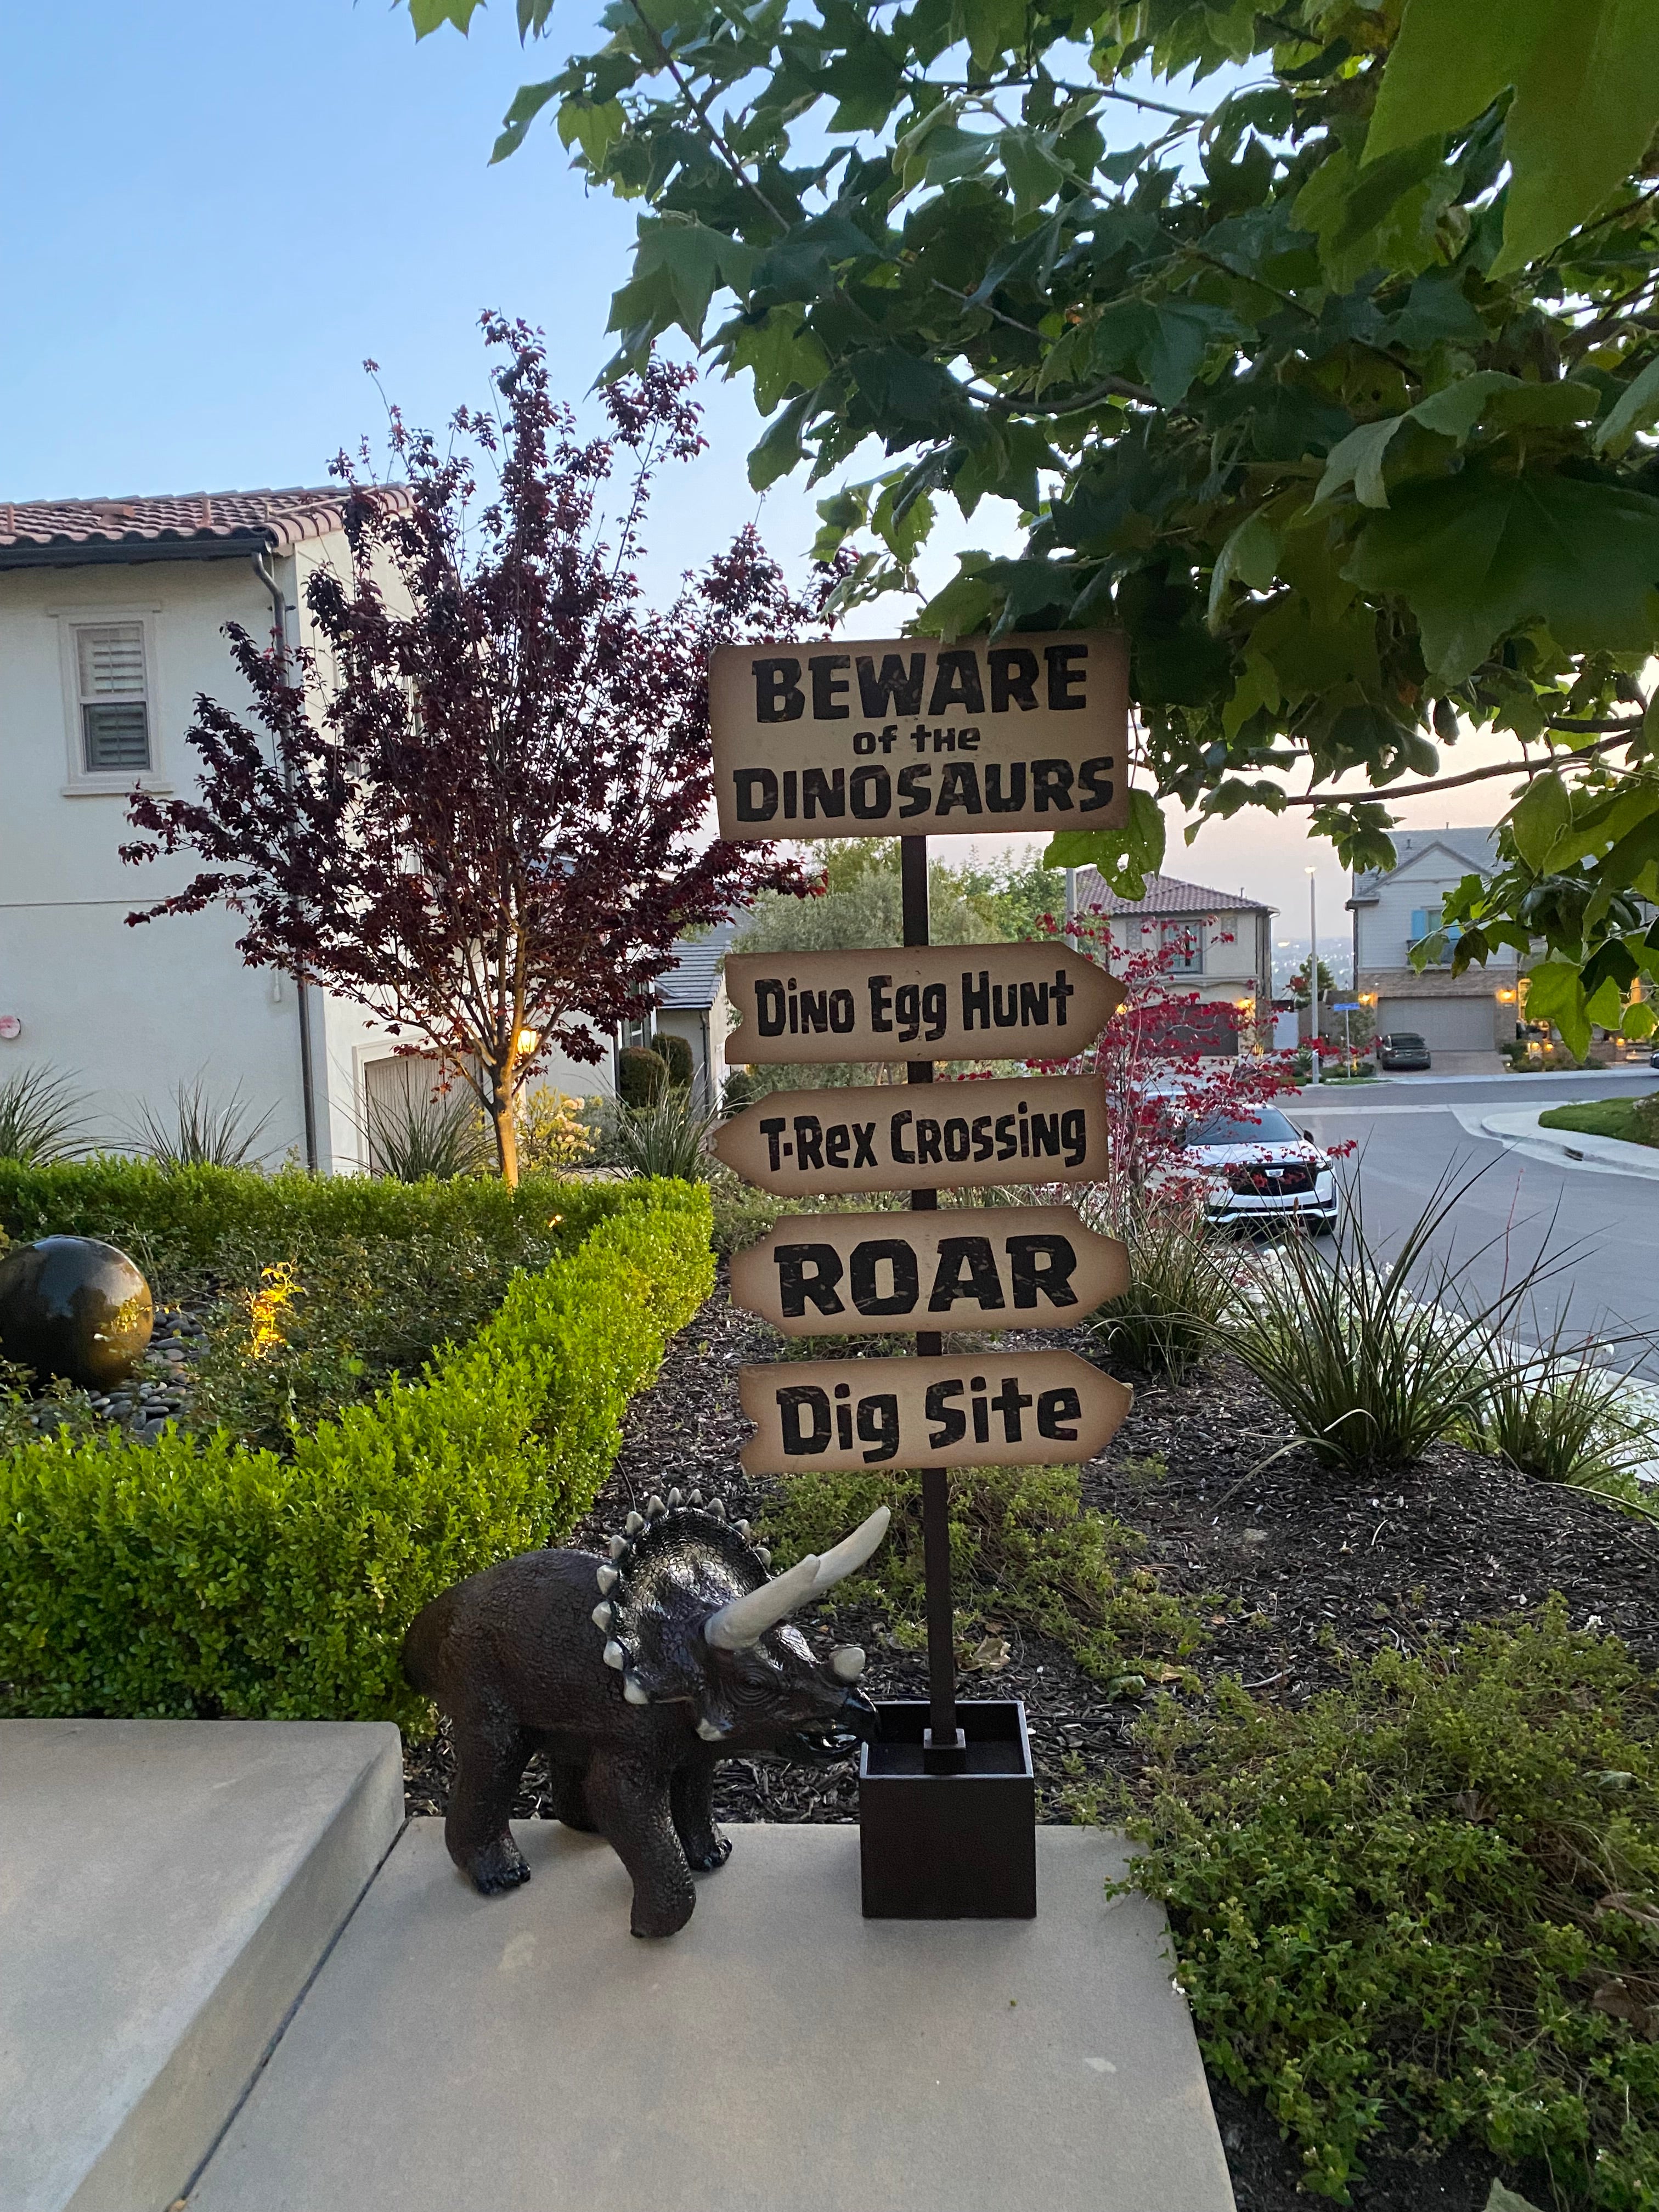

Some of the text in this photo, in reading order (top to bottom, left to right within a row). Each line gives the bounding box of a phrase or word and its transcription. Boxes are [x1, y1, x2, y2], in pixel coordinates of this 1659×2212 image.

[752, 644, 1088, 723] BEWARE
[853, 725, 898, 754] of
[733, 757, 1114, 822] DINOSAURS
[754, 969, 1074, 1042] Dino Egg Hunt
[759, 1101, 1086, 1172] T-Rex Crossing
[774, 1234, 1079, 1317] ROAR
[776, 1376, 1081, 1463] Dig Site
